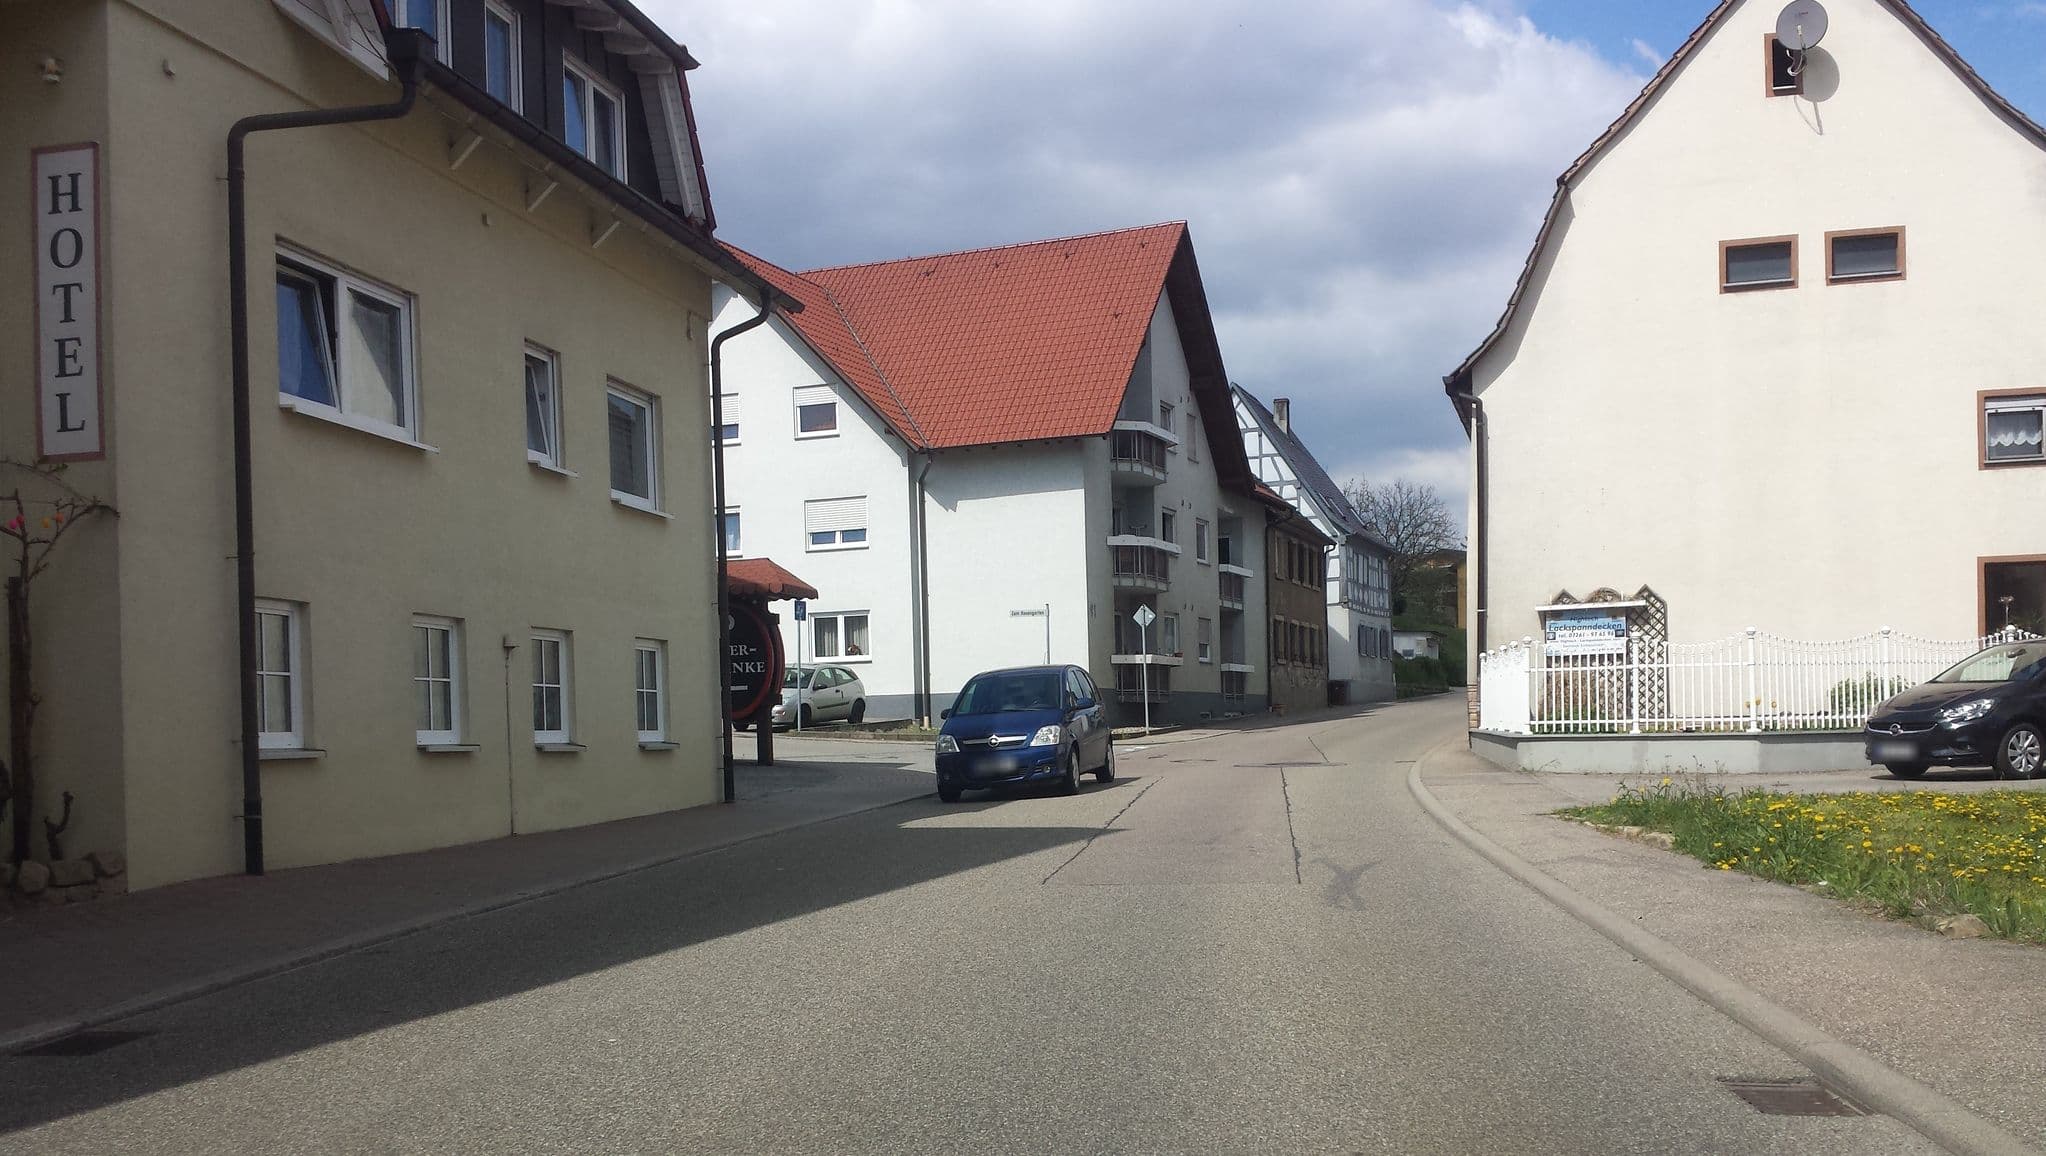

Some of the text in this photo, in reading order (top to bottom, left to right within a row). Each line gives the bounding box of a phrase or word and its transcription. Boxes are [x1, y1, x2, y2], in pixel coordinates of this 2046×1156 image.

[47, 172, 86, 433] HOTEL
[1548, 623, 1622, 632] Lackspanndecken
[729, 644, 757, 656] ER-
[732, 662, 766, 673] NKE
